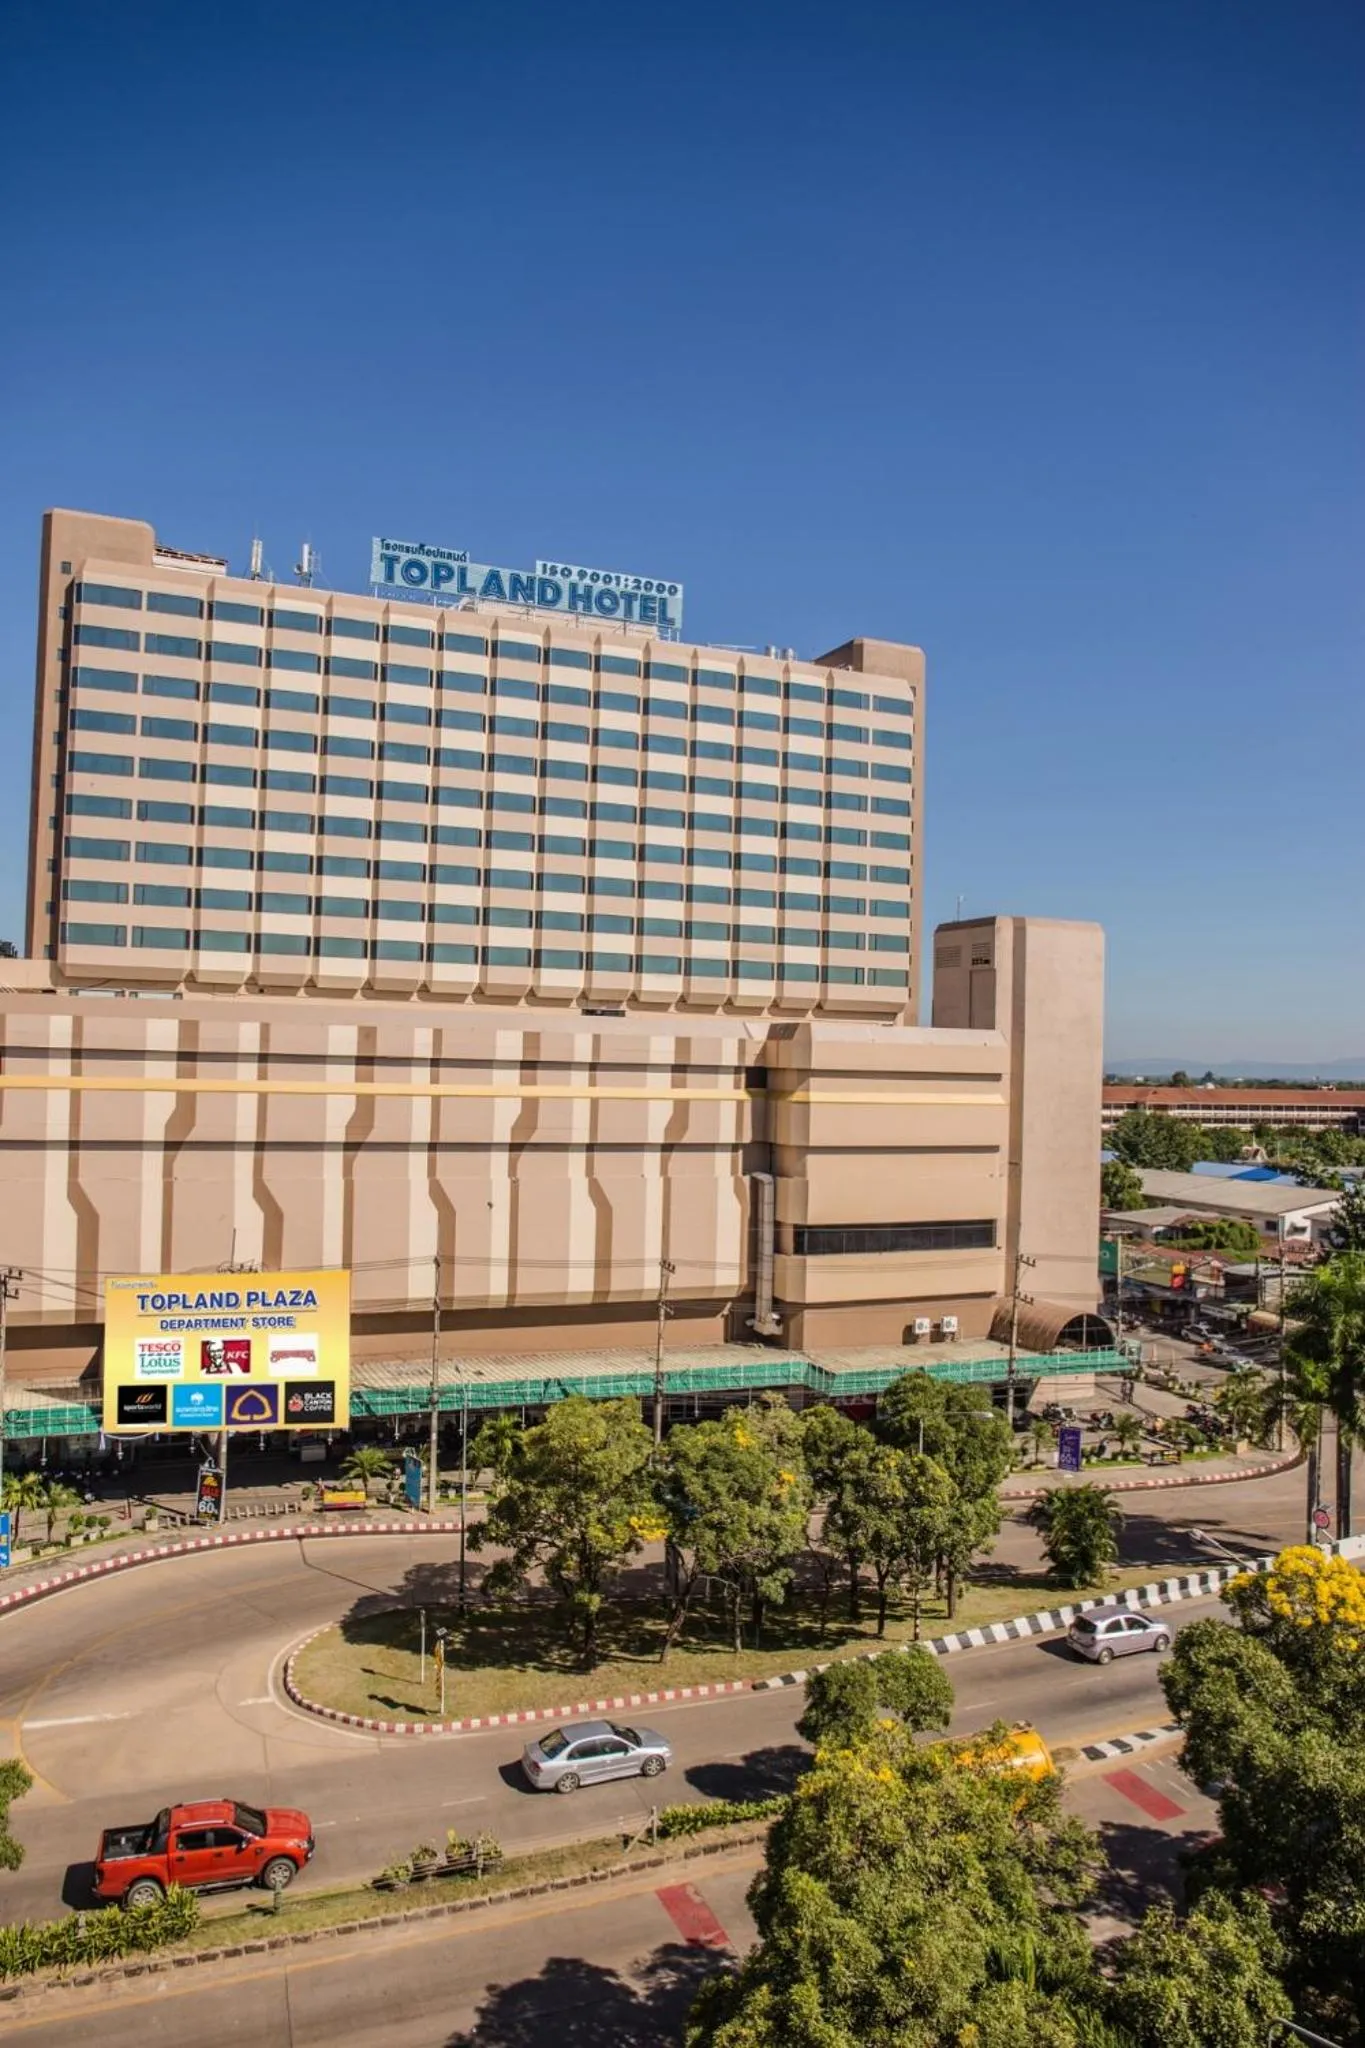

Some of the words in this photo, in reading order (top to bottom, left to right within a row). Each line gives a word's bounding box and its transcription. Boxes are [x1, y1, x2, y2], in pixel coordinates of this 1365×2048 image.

[541, 563, 573, 580] ISO
[577, 569, 678, 597] 9001:2000
[380, 552, 562, 607] TOPLAND
[568, 582, 676, 625] HOTEL
[137, 1292, 240, 1311] TOPLAND
[246, 1290, 318, 1308] PLAZA
[160, 1318, 246, 1331] DEPARTMENT
[252, 1317, 295, 1328] STORE
[138, 1342, 182, 1353] TESCO
[226, 1350, 249, 1360] KFC
[140, 1356, 181, 1368] Lotus
[304, 1392, 333, 1400] BLACK
